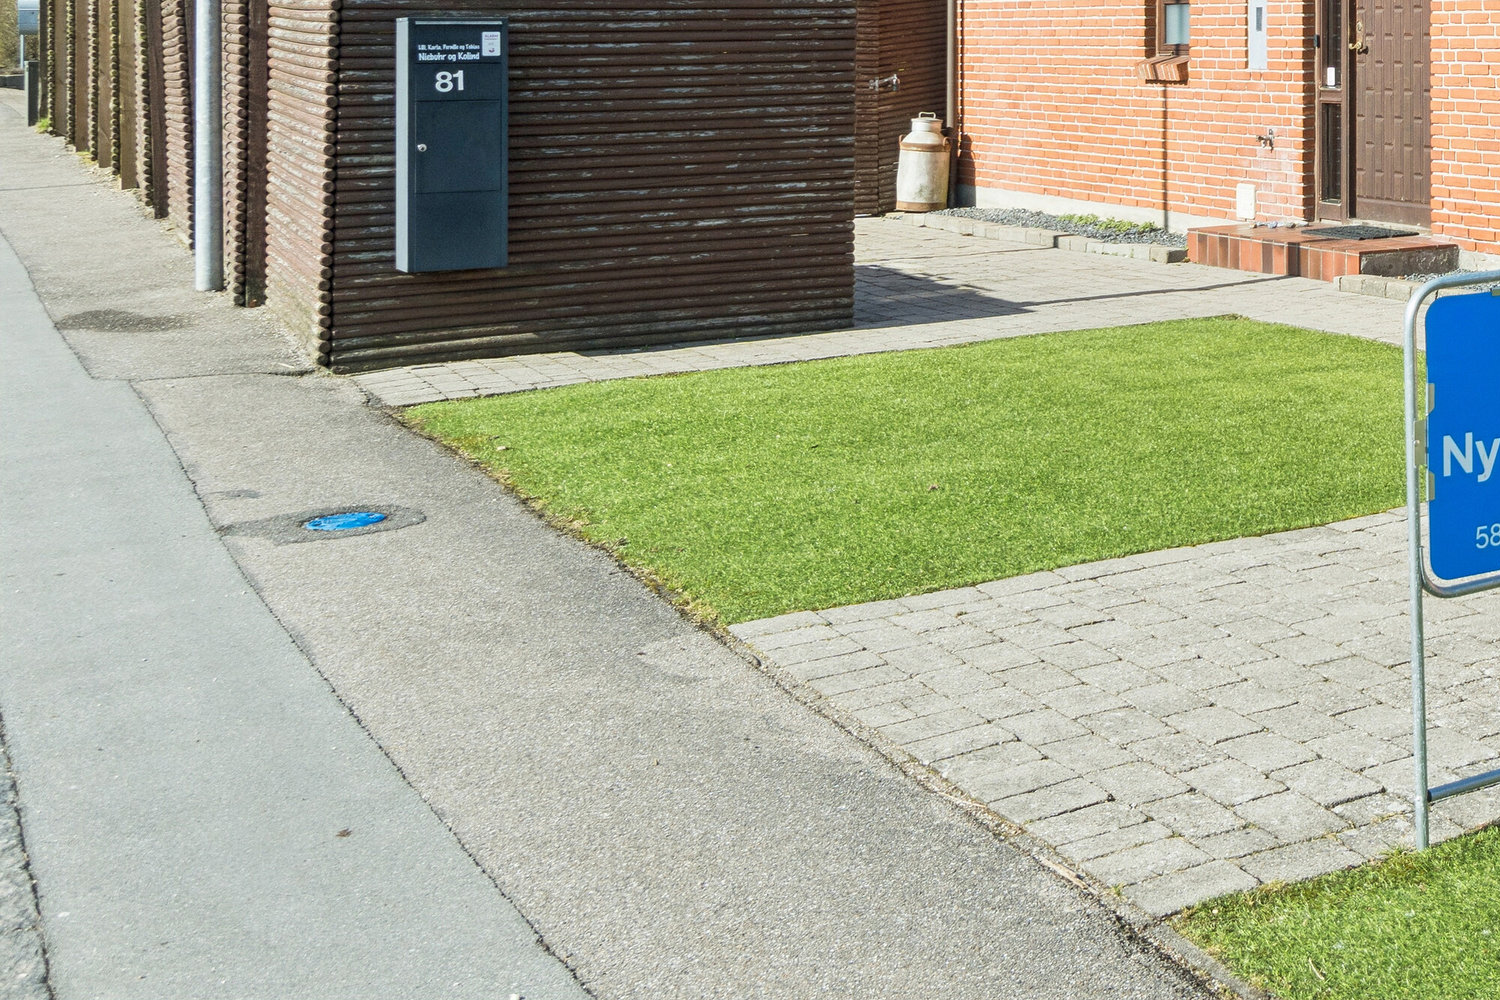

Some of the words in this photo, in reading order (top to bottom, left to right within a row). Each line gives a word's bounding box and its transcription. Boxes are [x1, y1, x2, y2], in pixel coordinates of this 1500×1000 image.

[447, 53, 457, 62] og
[458, 51, 480, 60] Kolind
[435, 70, 464, 93] 81
